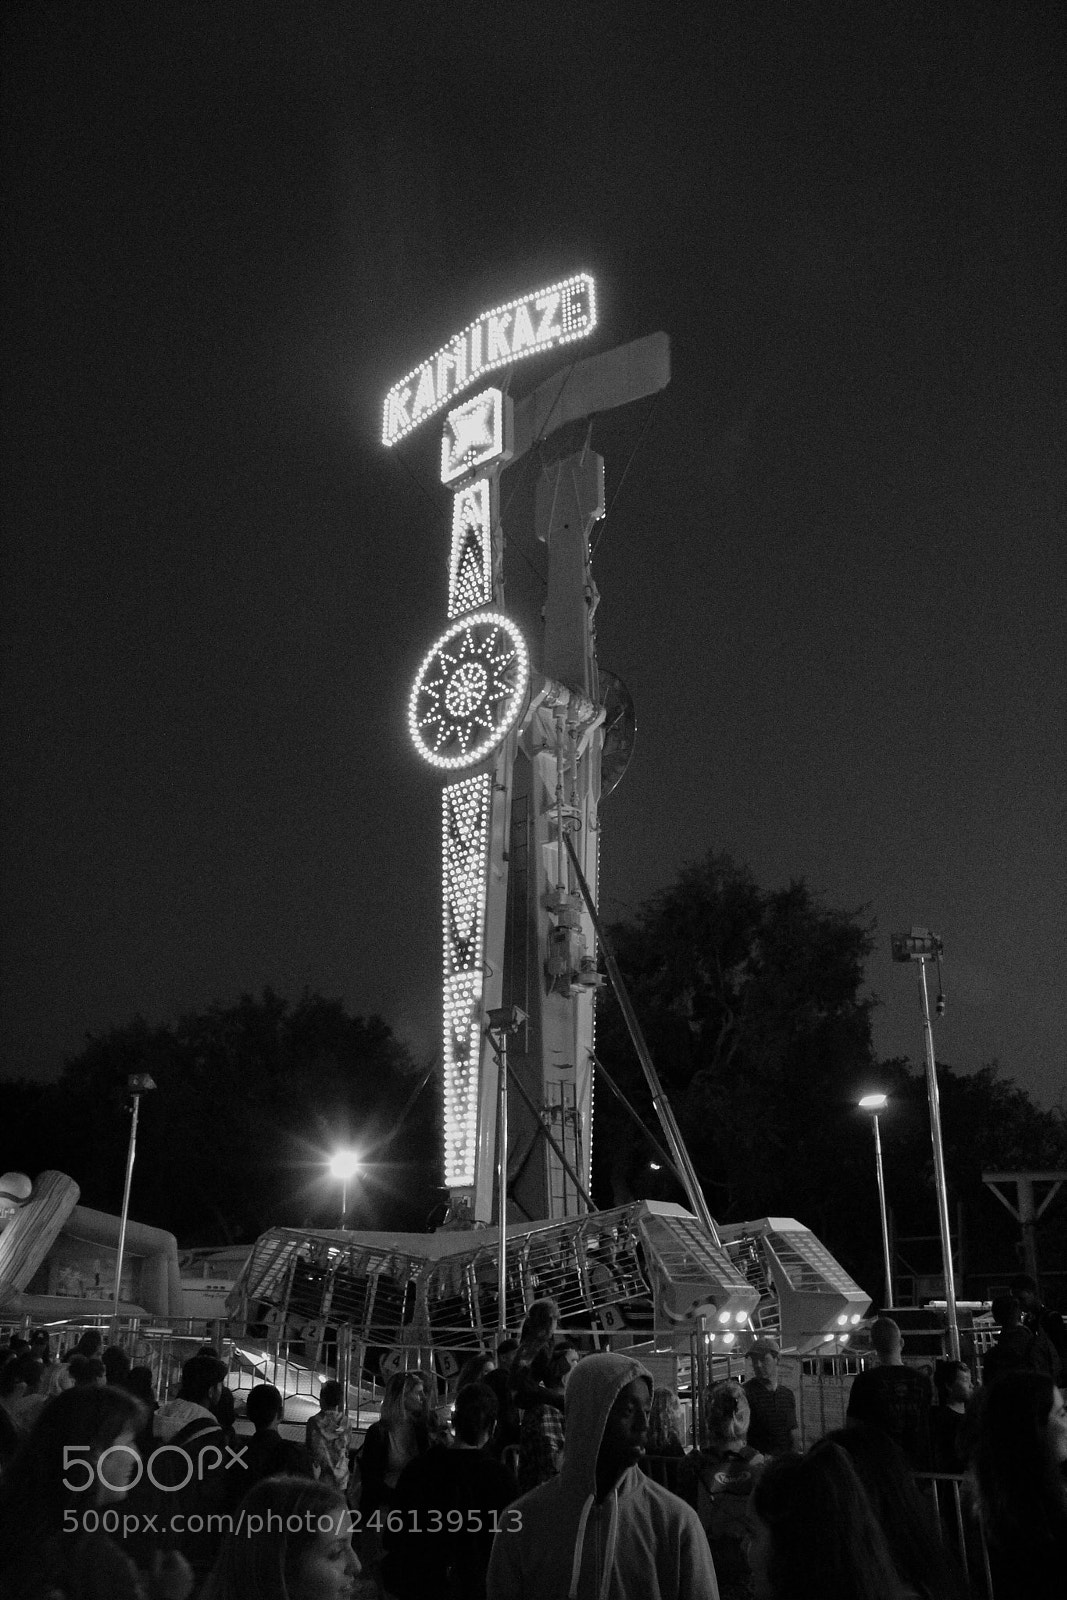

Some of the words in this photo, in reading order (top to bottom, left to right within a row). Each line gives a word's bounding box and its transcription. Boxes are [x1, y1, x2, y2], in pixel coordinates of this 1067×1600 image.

[387, 282, 586, 438] KAMIKAZE
[605, 1311, 614, 1325] 8
[308, 1326, 317, 1338] 2
[393, 1355, 401, 1368] 4
[443, 1356, 451, 1370] 5
